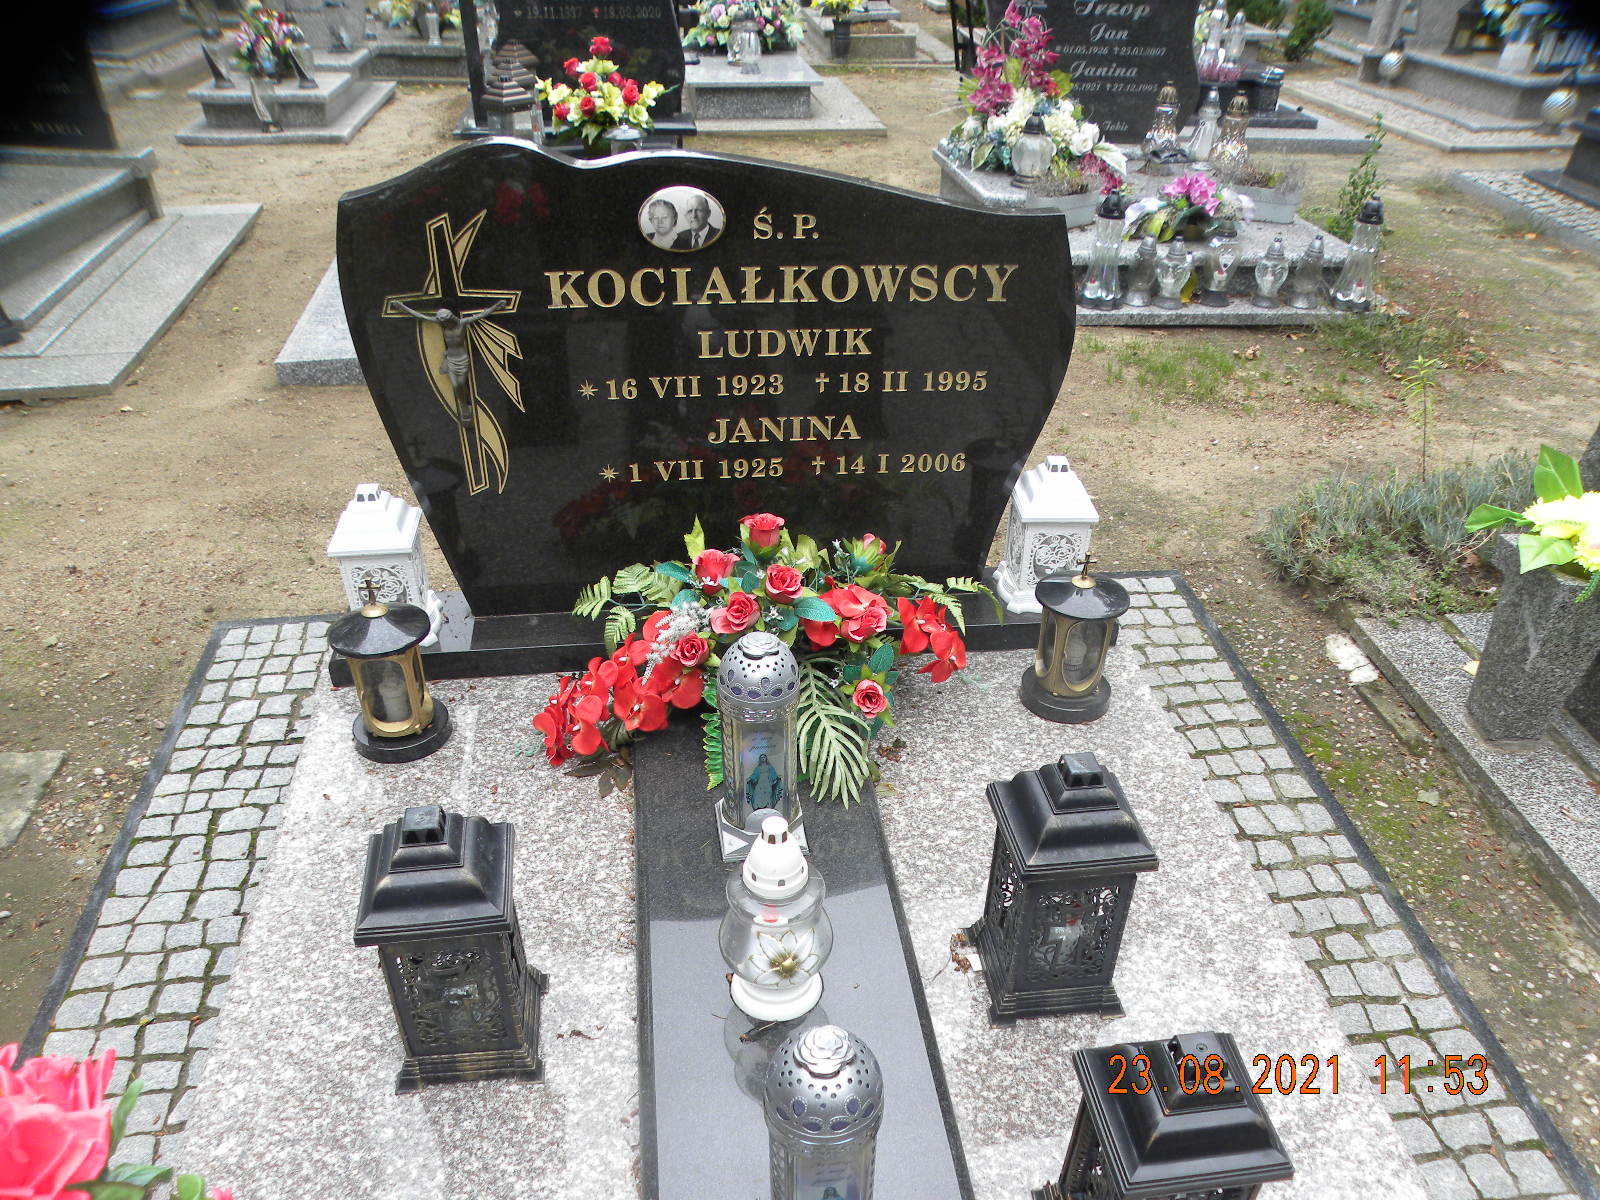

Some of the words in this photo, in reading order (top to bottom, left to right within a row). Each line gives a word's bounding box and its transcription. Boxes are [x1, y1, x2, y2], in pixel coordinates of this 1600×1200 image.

[1090, 23, 1128, 41] Jan
[1070, 60, 1138, 80] Janina
[543, 263, 1018, 310] KOCIAŁKOWSCY
[697, 327, 873, 360] LUDWIK
[606, 378, 638, 400] 16
[649, 375, 702, 398] VII
[716, 373, 786, 397] 1923
[838, 371, 870, 393] 18
[882, 370, 909, 393] II
[923, 370, 989, 392] 1995
[707, 415, 862, 444] JANINA
[628, 463, 643, 483] 1
[653, 459, 705, 481] VII
[718, 456, 784, 479] 1925
[836, 455, 867, 475] 14
[876, 453, 890, 474] I
[899, 452, 967, 473] 2006
